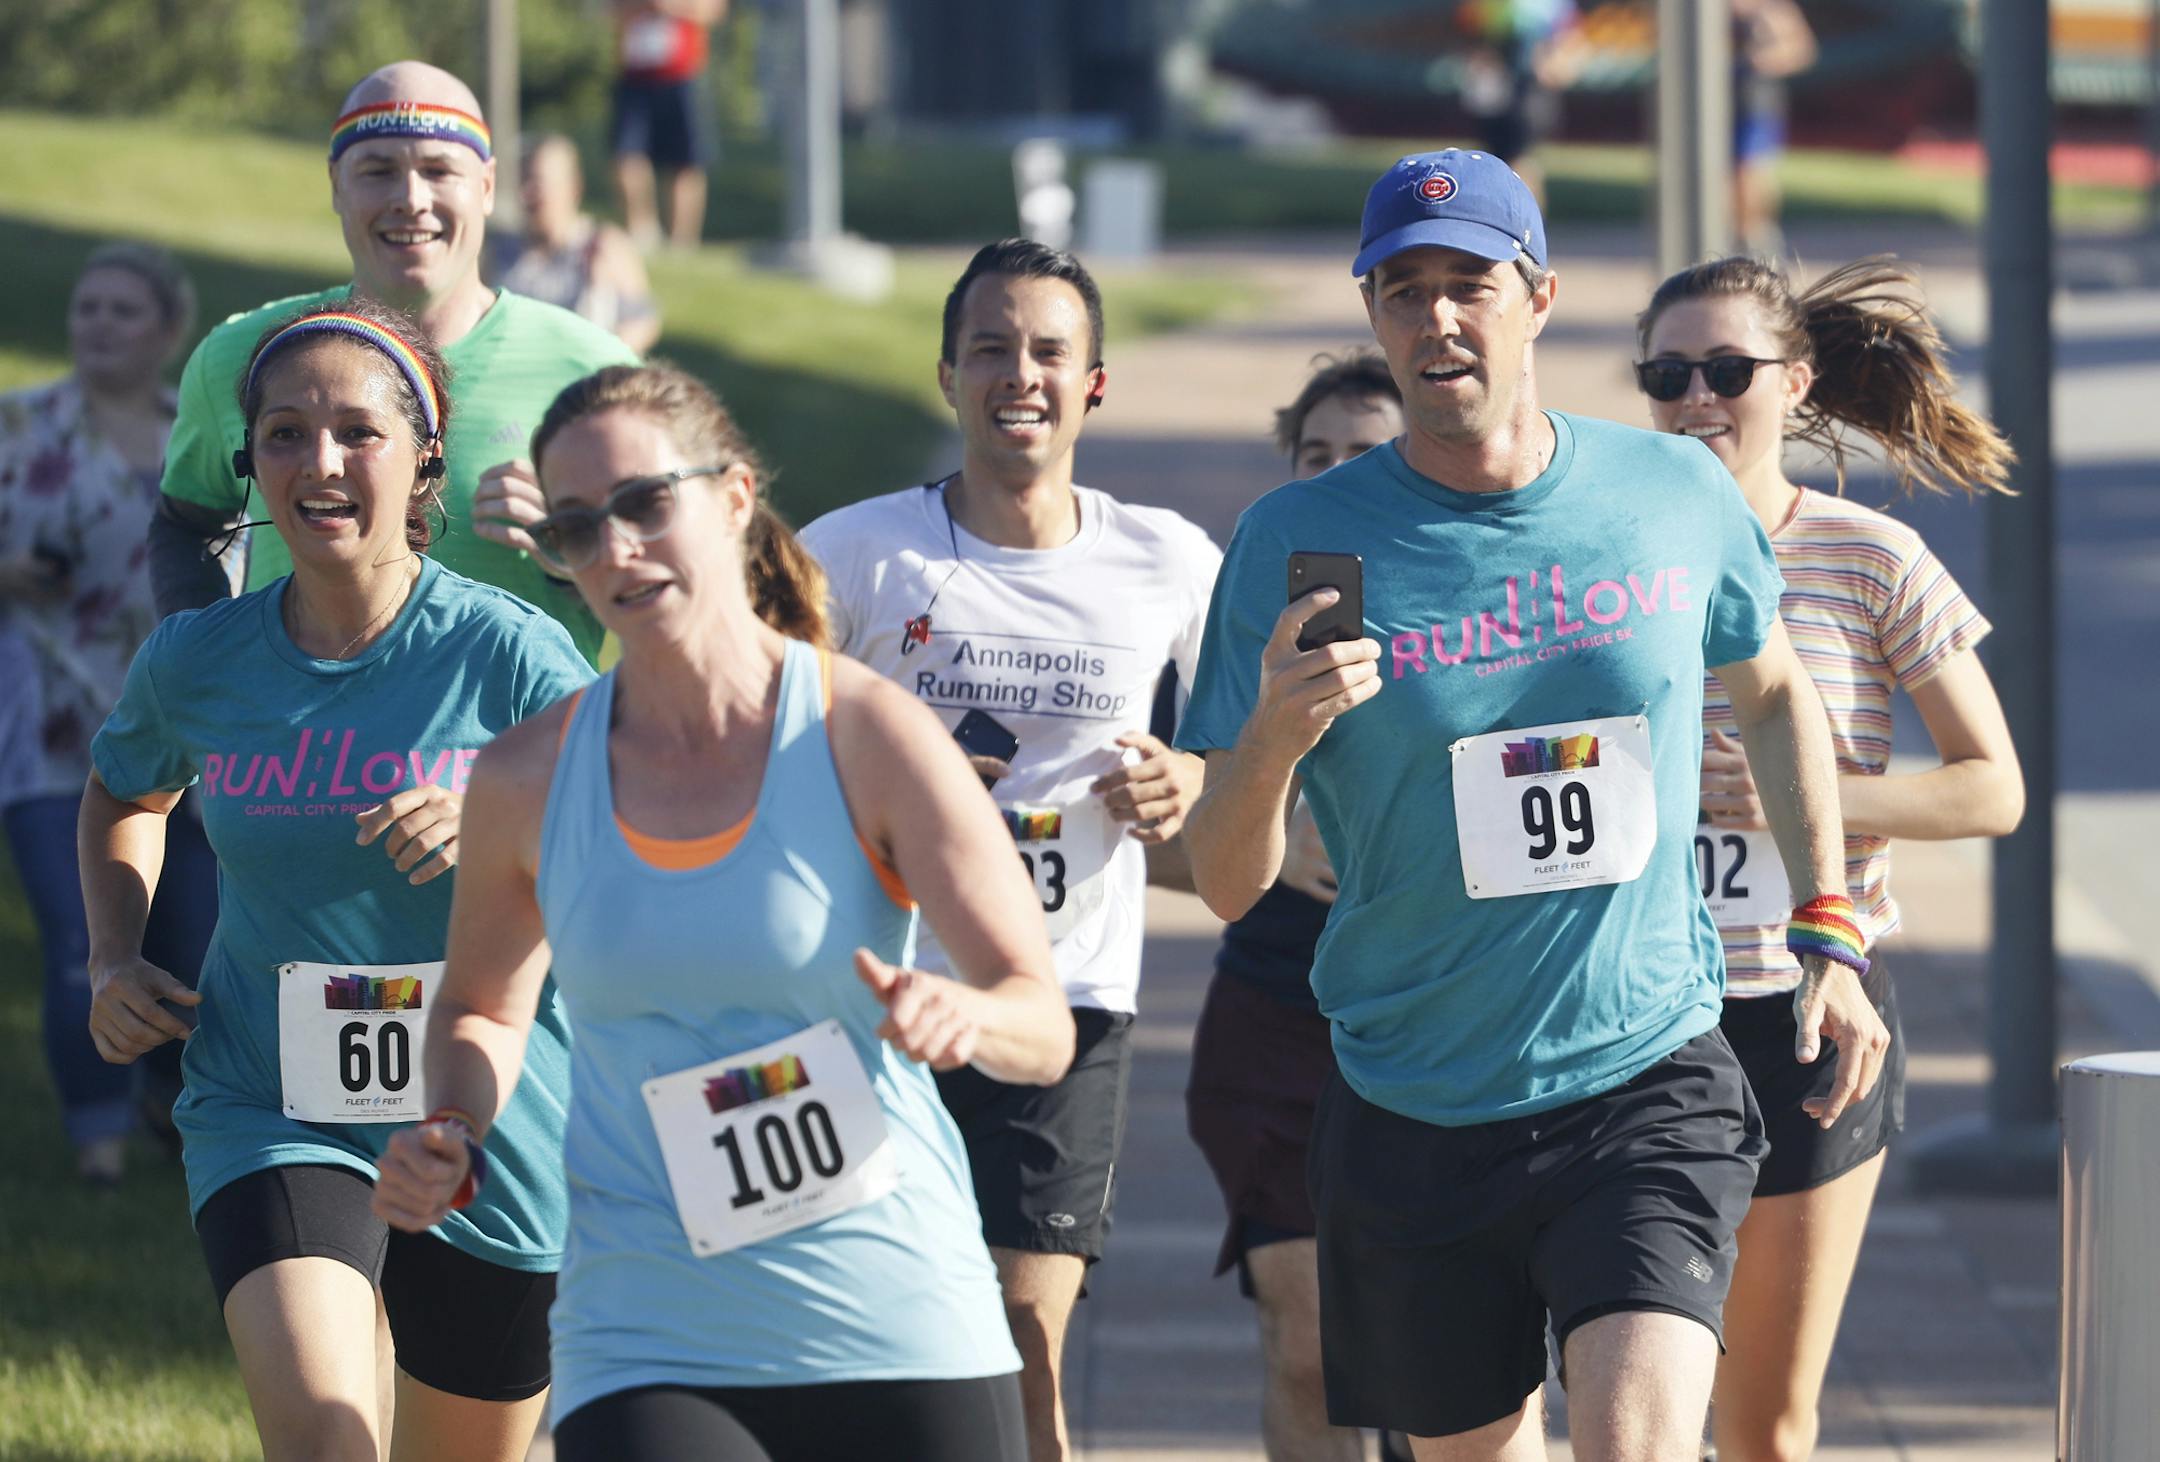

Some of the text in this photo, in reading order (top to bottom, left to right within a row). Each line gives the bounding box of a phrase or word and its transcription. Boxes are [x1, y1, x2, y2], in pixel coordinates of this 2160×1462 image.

[356, 102, 459, 132] RUN LOVE
[1391, 564, 1693, 680] RUN LOVE
[951, 639, 1106, 677] Annapolis
[1474, 627, 1634, 678] CAPITAL CITY PRIDE 5K
[916, 671, 1127, 718] Running Shop
[203, 728, 480, 798] RUN LOVE
[244, 804, 301, 817] CAPITAL
[304, 803, 338, 816] CITY
[1521, 781, 1595, 860] 99
[1534, 860, 1591, 875] FLEET FEET
[339, 1020, 411, 1093] 60
[345, 1097, 404, 1106] FLEET FEET
[712, 1100, 845, 1210] 100
